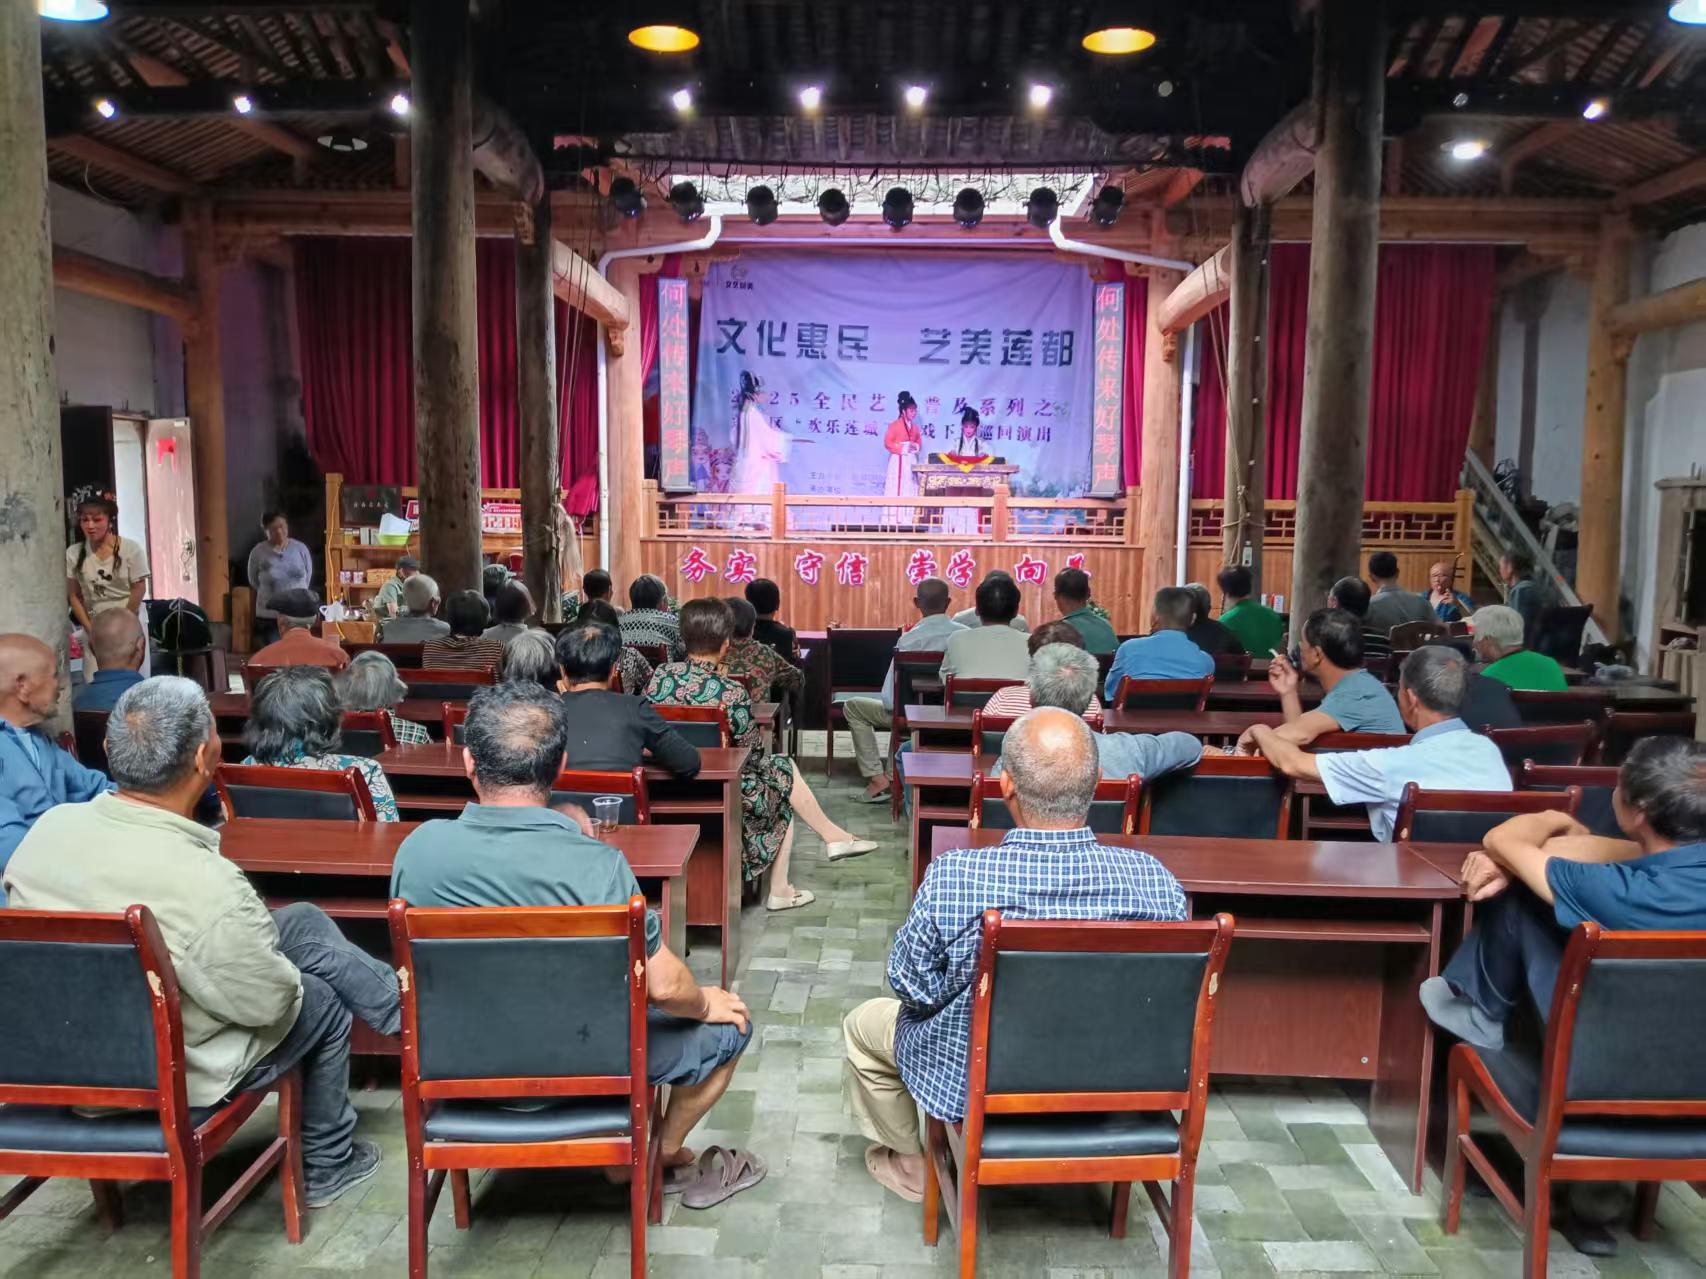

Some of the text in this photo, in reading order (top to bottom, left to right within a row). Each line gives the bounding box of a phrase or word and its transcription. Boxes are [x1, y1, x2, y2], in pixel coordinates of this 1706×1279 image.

[716, 317, 1074, 367] 文化惠民 艺美莲都
[681, 547, 758, 583] 务实
[794, 549, 869, 585] 守信
[906, 549, 976, 587] 崇学
